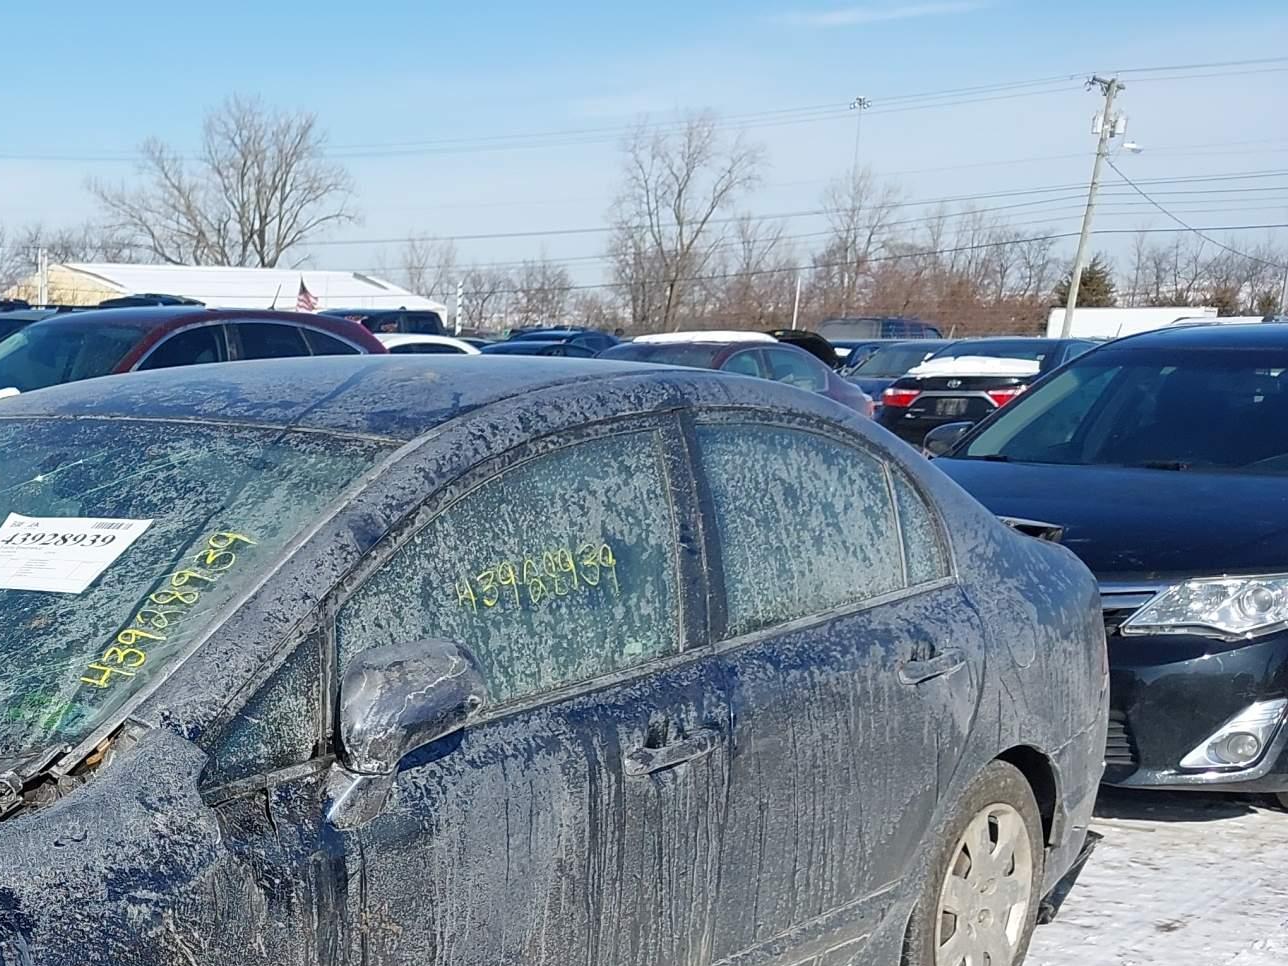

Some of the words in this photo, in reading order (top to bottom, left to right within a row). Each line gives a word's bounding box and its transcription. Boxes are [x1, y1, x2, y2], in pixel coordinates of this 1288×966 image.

[0, 532, 117, 548] 43928939
[80, 531, 259, 688] 43928939
[455, 543, 620, 616] 43928939
